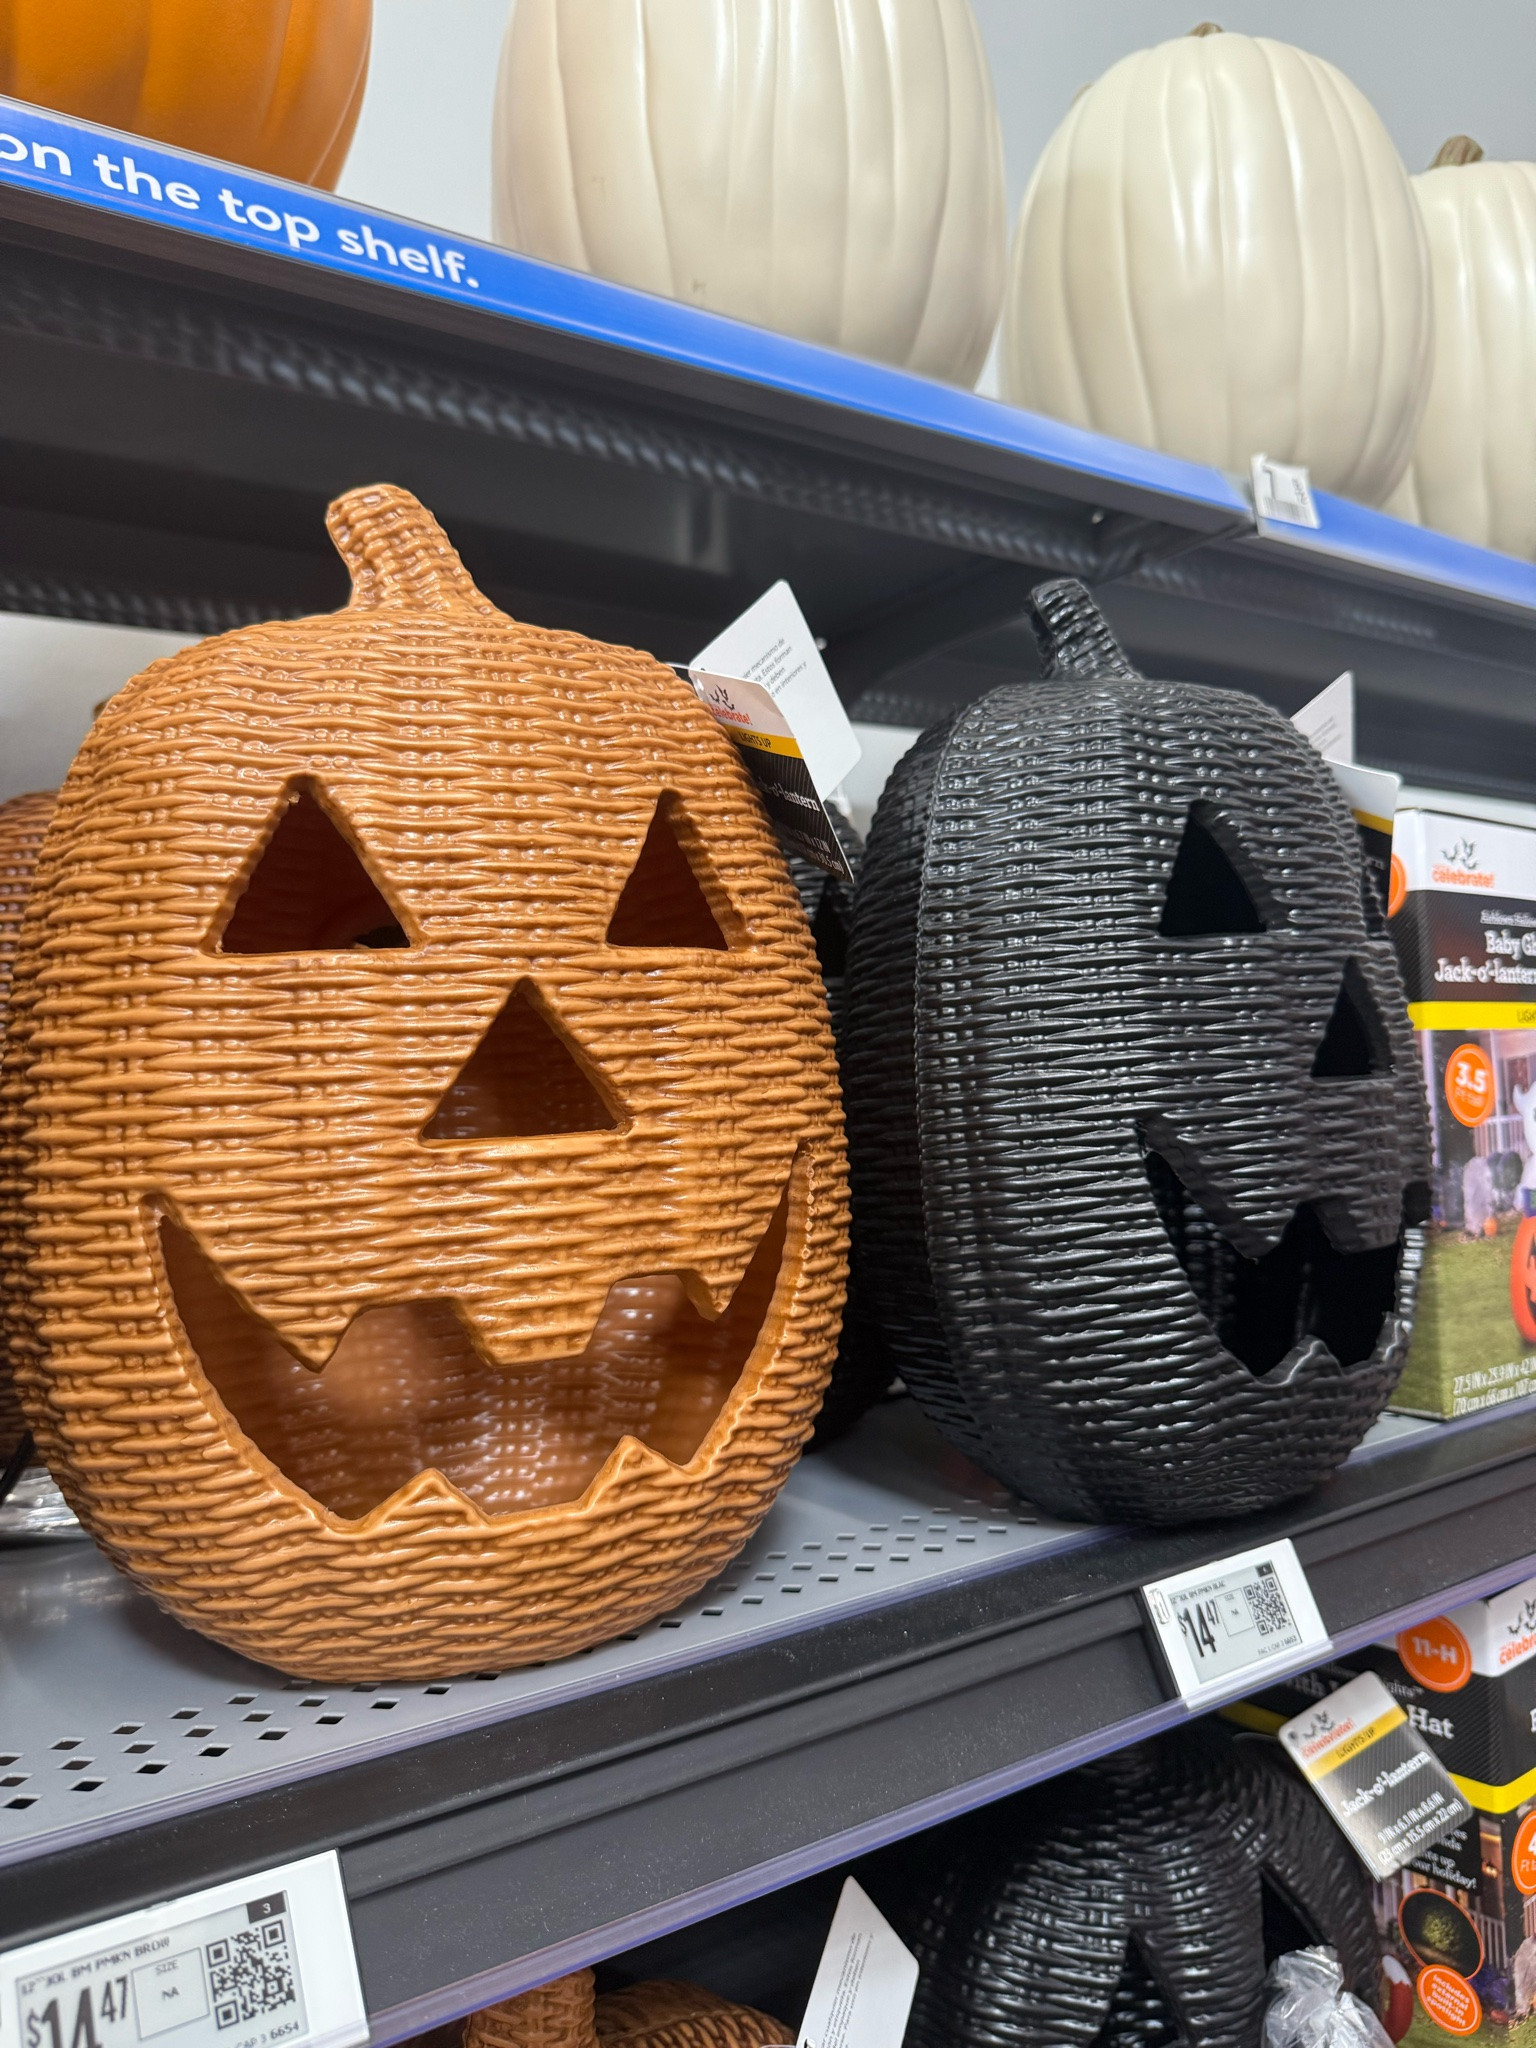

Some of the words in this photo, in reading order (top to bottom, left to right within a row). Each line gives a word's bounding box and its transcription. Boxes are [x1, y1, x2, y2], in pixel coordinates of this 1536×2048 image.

[0, 132, 72, 176] on
[93, 153, 201, 210] the
[218, 187, 321, 250] top
[336, 226, 480, 288] shelf.
[759, 737, 772, 749] UP
[1484, 929, 1522, 961] Baby
[1455, 1061, 1488, 1093] 3.5
[1406, 1703, 1455, 1739] Hat
[1432, 1861, 1477, 1890] holiday!
[263, 1902, 272, 1915] 3
[134, 1936, 170, 1958] BROW
[155, 1959, 180, 1977] SIZE
[101, 1974, 129, 2024] 47
[161, 1986, 179, 2000] NA
[270, 2020, 299, 2040] 6654
